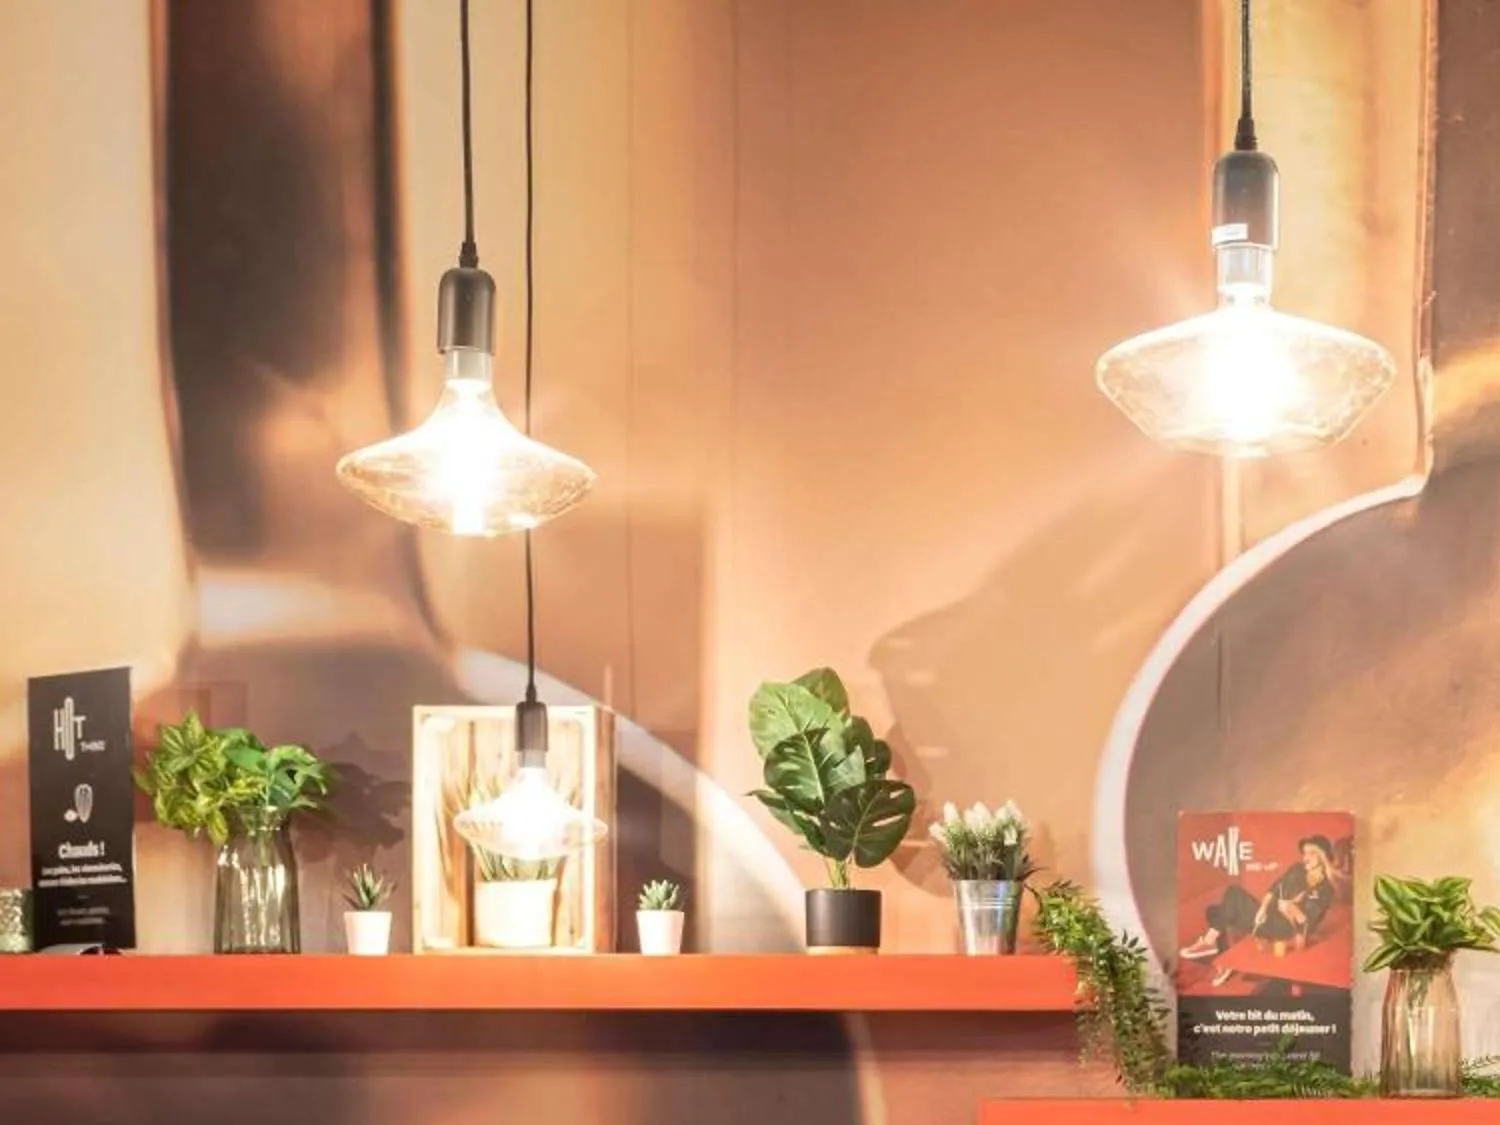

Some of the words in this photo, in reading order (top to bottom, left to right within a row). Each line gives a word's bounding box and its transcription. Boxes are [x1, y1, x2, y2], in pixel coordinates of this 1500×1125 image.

[1215, 1010, 1246, 1021] Votre
[1247, 1010, 1262, 1021] hit
[1263, 1010, 1279, 1021] du
[1222, 1024, 1252, 1034] notre
[1253, 1023, 1280, 1036] petit
[1281, 1023, 1331, 1036] déjeuner
